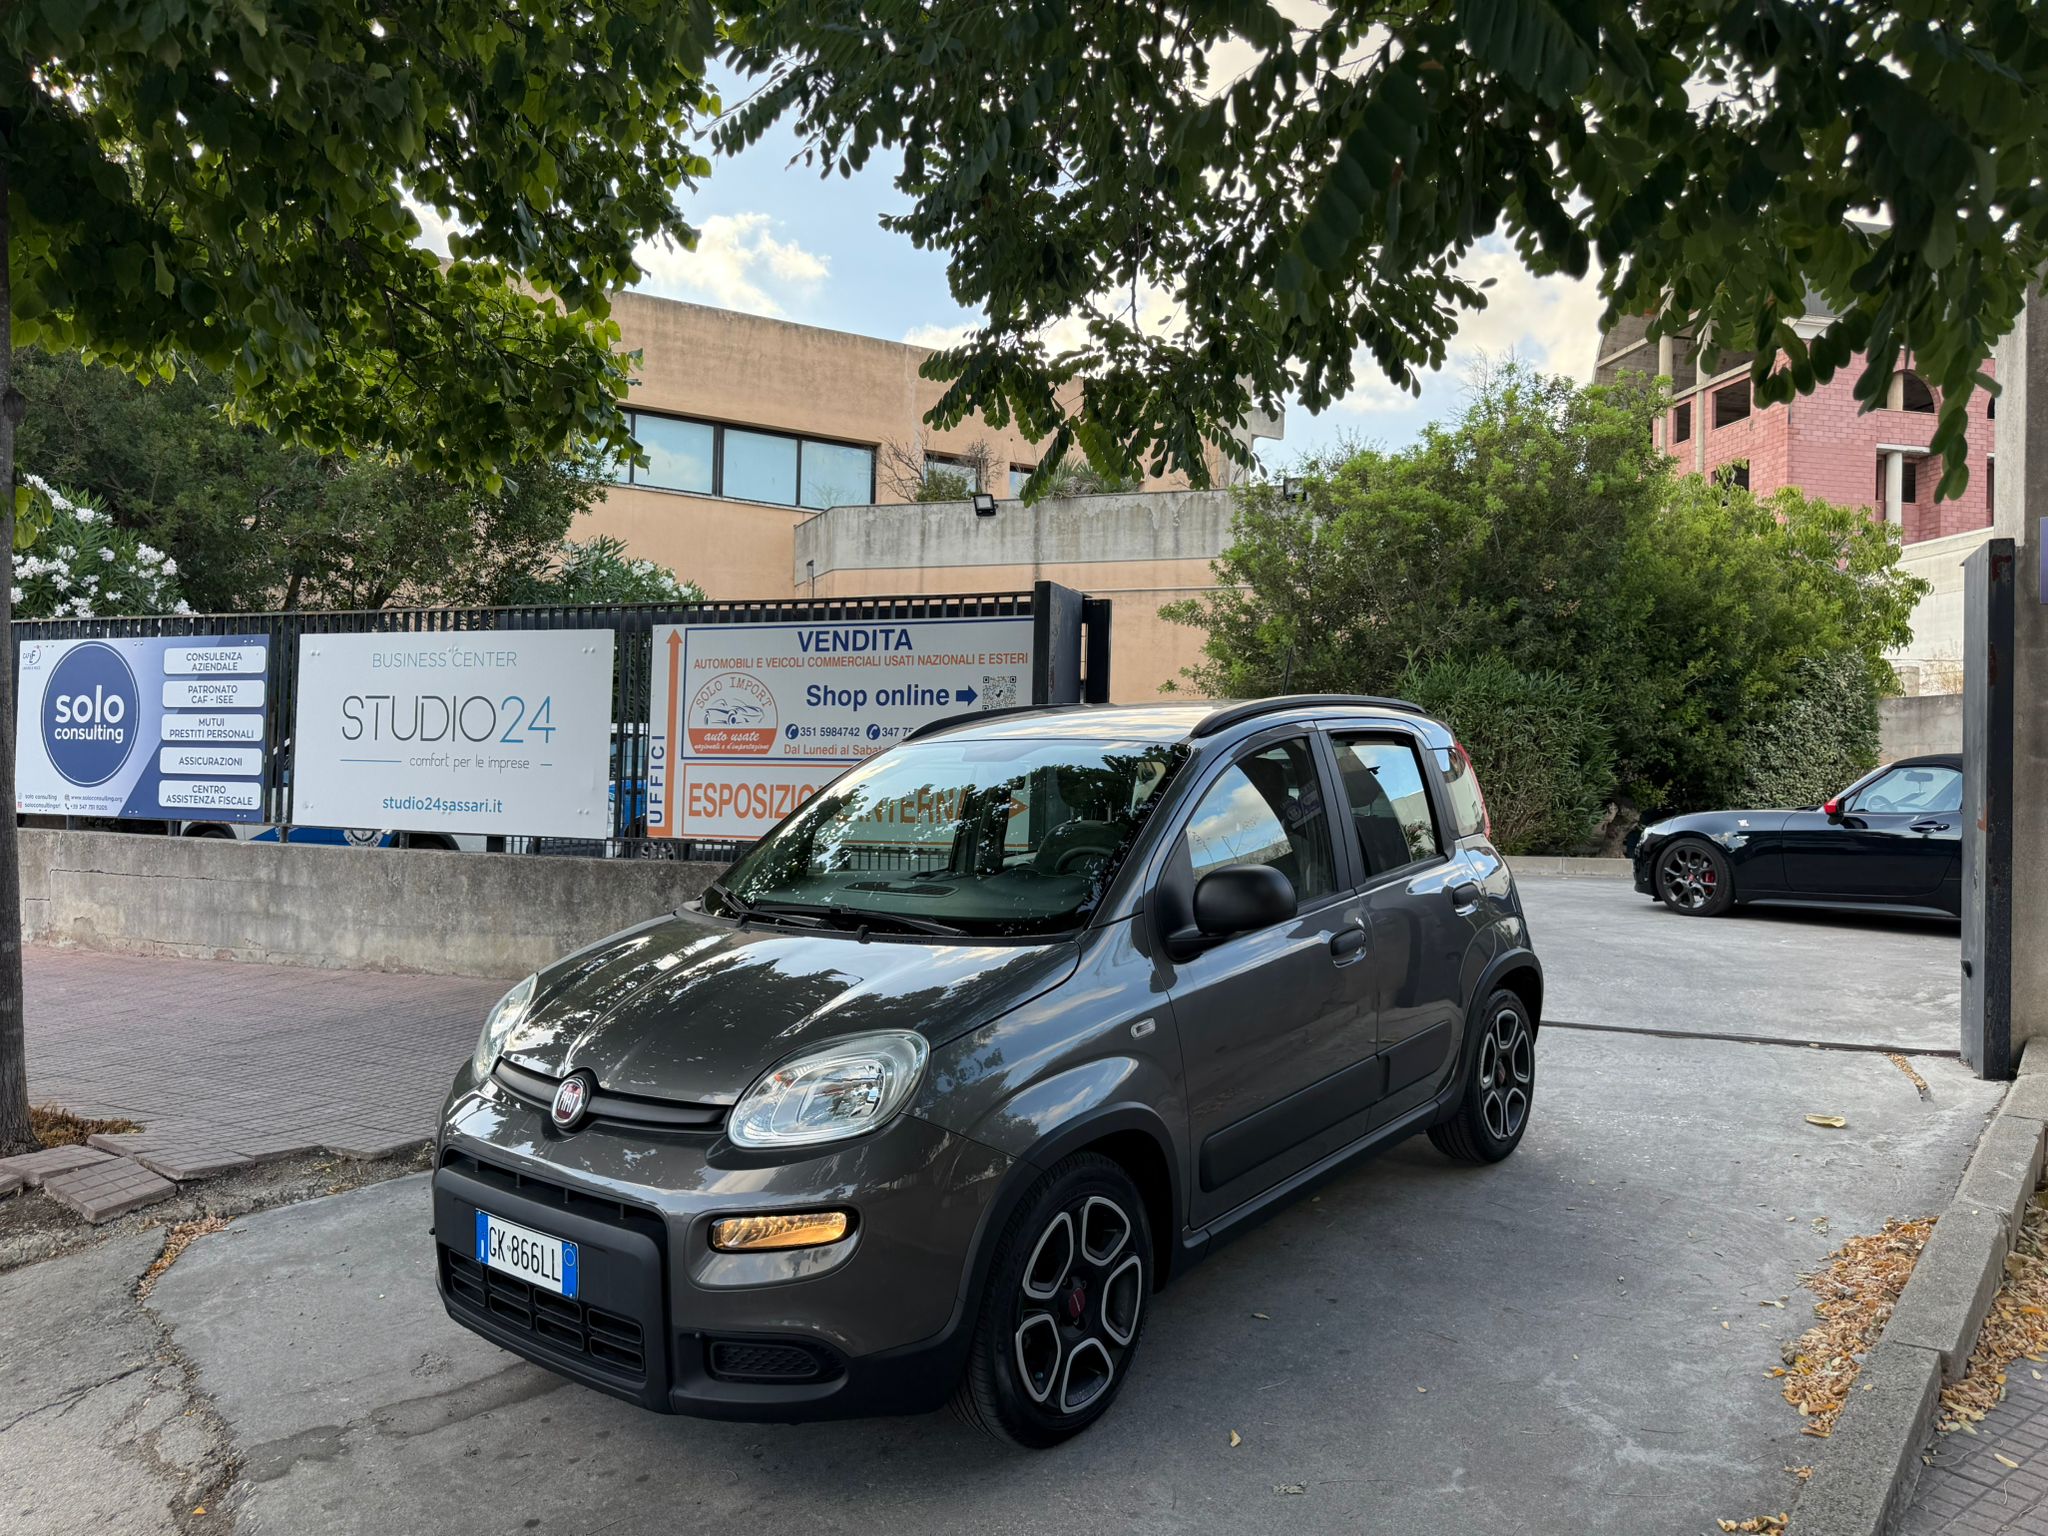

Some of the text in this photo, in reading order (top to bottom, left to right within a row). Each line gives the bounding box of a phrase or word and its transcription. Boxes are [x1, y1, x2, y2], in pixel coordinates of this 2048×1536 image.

[798, 628, 913, 652] VENDITA
[186, 652, 243, 661] CONSULENZA
[372, 651, 518, 668] BUSINESS CENTER
[694, 652, 1028, 670] AUTOMOBILI E VEICOLI COMMERCIALI USATI NAZIONALI E ESTERI
[191, 662, 238, 671] AZIENDALE
[187, 685, 238, 694] PATRONATO
[696, 676, 773, 708] SOLO IMPORT
[191, 695, 208, 704] CAF
[215, 694, 234, 704] ISEE
[806, 683, 950, 712] Shop online
[55, 684, 125, 724] solo
[198, 717, 225, 727] MUTUI
[341, 695, 556, 743] STUDIO24
[54, 724, 124, 744] consulting
[169, 729, 254, 739] PRESTITI PERSONALI
[703, 731, 760, 742] auto usate
[800, 727, 860, 737] 351 5984742
[882, 727, 899, 737] 347
[784, 744, 800, 755] Dal
[840, 744, 849, 755] al
[178, 756, 243, 766] ASSICURAZIONI
[409, 752, 530, 774] comfort per le imprese
[649, 735, 665, 824] UFFICI
[191, 784, 227, 794] CENTRO
[166, 794, 254, 806] ASSISTENZA FISCALE
[382, 796, 503, 814] studio24sassari.it
[558, 1090, 579, 1113] FIAT
